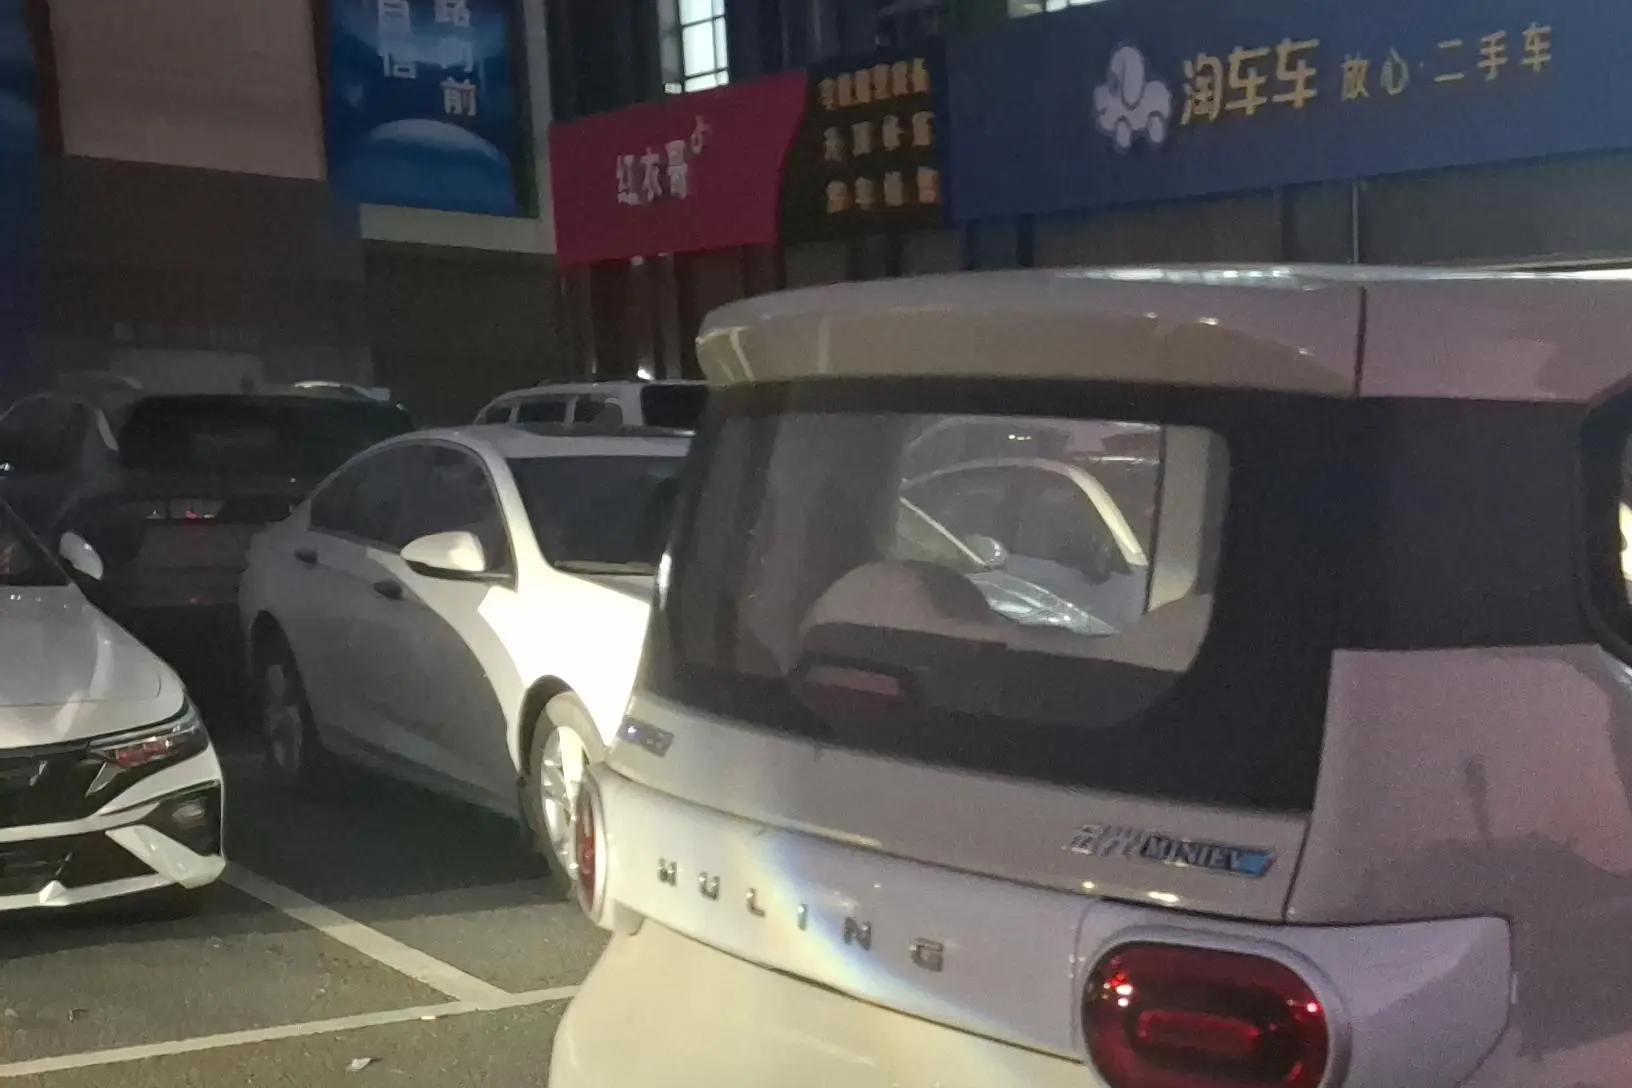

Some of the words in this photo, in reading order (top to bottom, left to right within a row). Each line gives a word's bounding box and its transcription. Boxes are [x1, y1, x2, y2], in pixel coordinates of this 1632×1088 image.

[1180, 37, 1319, 125] 淘车车
[657, 857, 944, 972] WULING
